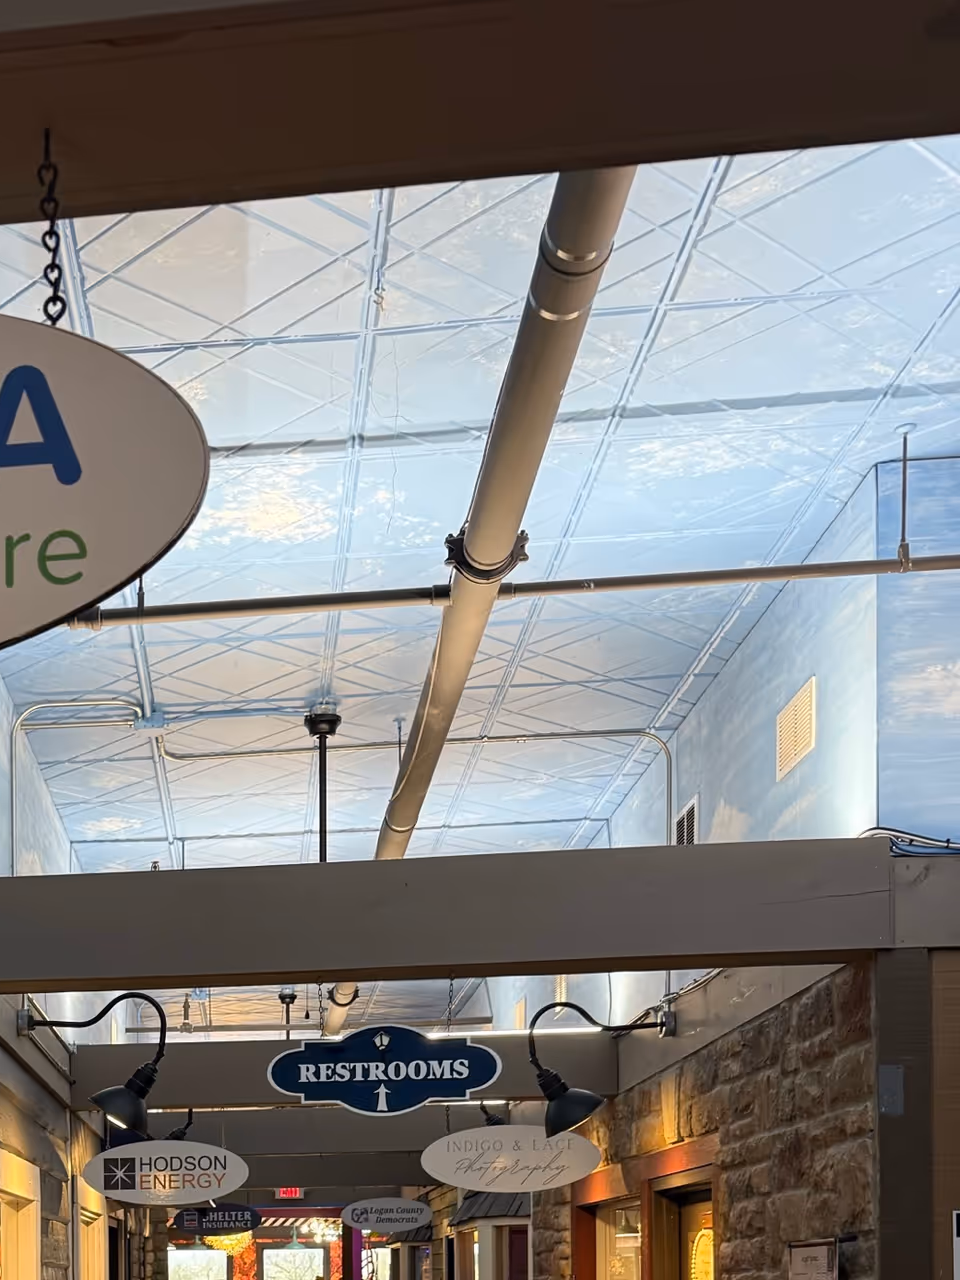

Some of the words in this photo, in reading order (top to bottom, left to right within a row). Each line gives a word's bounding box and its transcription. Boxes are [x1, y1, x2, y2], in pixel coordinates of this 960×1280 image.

[298, 1059, 470, 1083] RESTROOMS
[446, 1139, 503, 1153] INDIGO
[512, 1139, 522, 1151] &
[532, 1138, 575, 1150] LACE
[140, 1155, 227, 1172] HODSON
[454, 1151, 570, 1186] Photography
[140, 1173, 226, 1190] ENERGY
[369, 1207, 394, 1216] Logan
[395, 1206, 424, 1215] County
[202, 1221, 252, 1229] INSURANCE
[375, 1216, 419, 1224] Democrats
